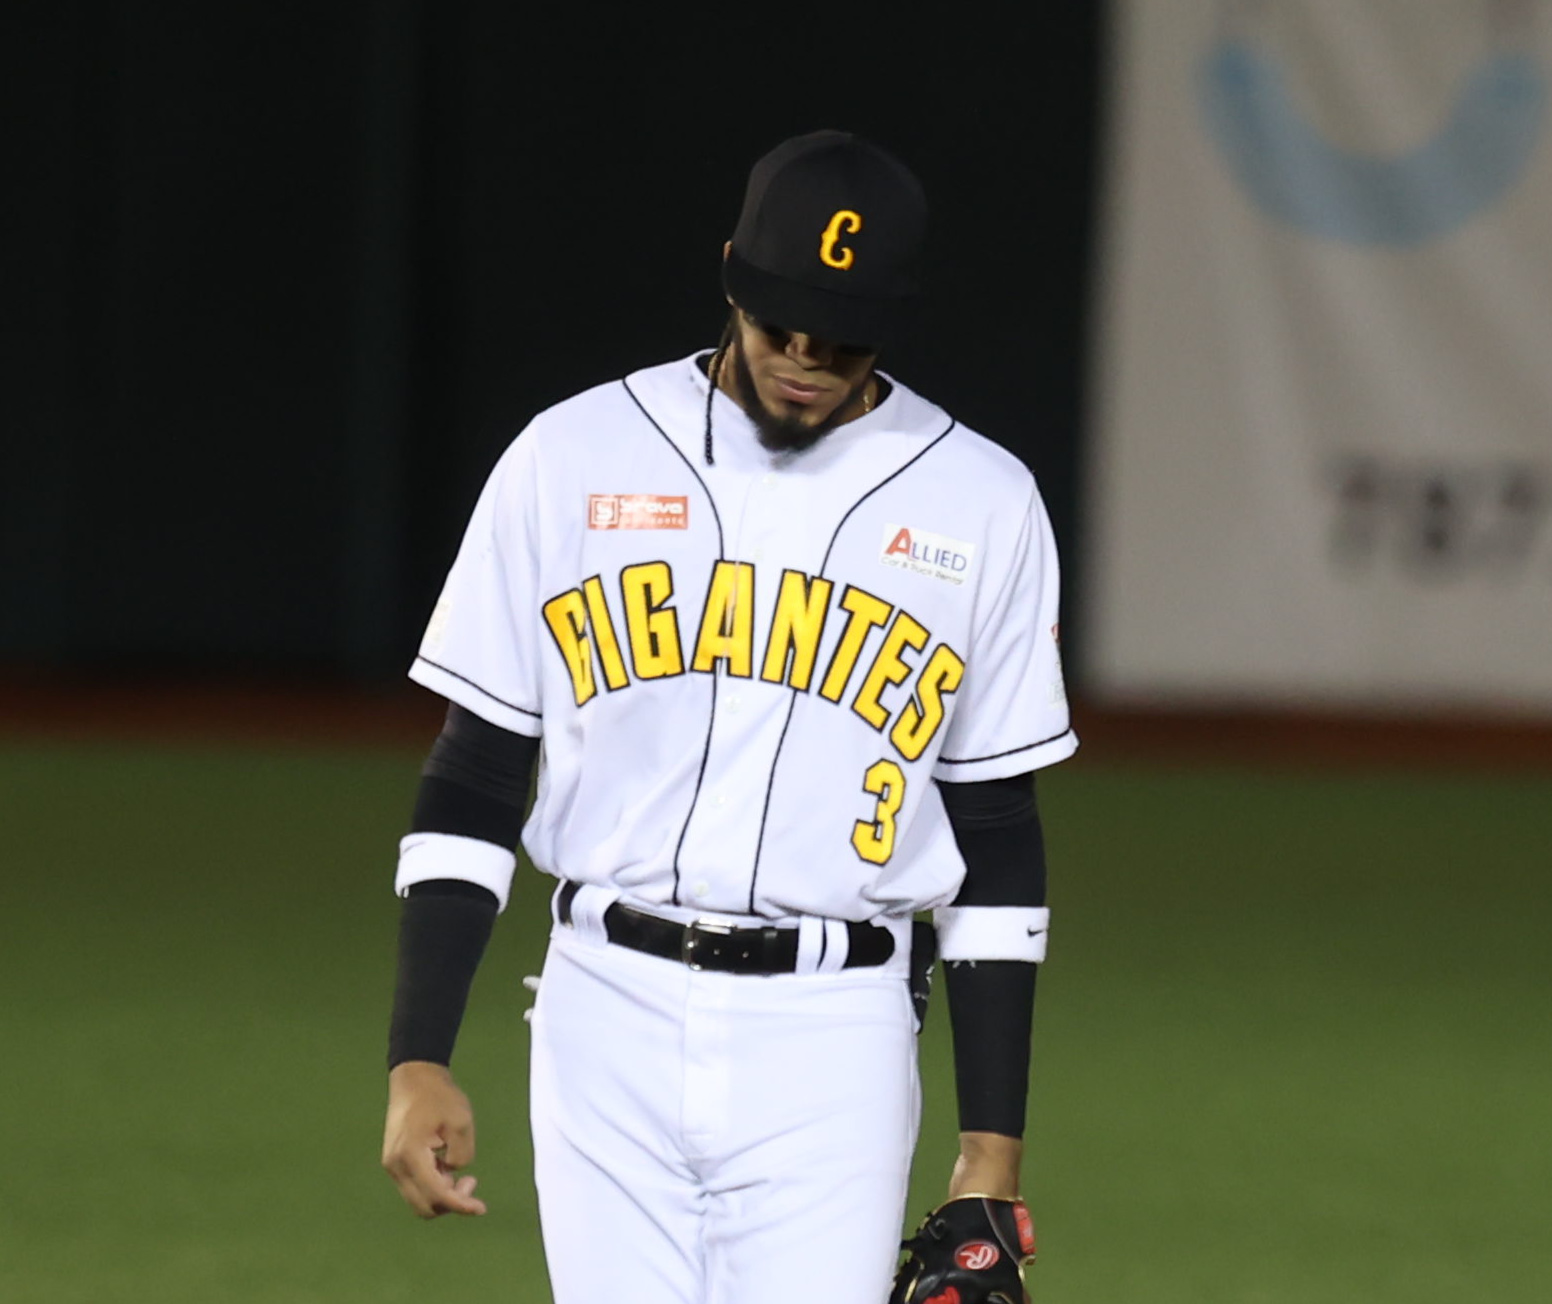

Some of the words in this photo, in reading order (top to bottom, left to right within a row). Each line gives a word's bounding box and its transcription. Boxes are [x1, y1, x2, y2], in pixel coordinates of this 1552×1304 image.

[819, 209, 862, 271] C
[542, 559, 966, 762] GIGANTES
[850, 758, 906, 867] 3
